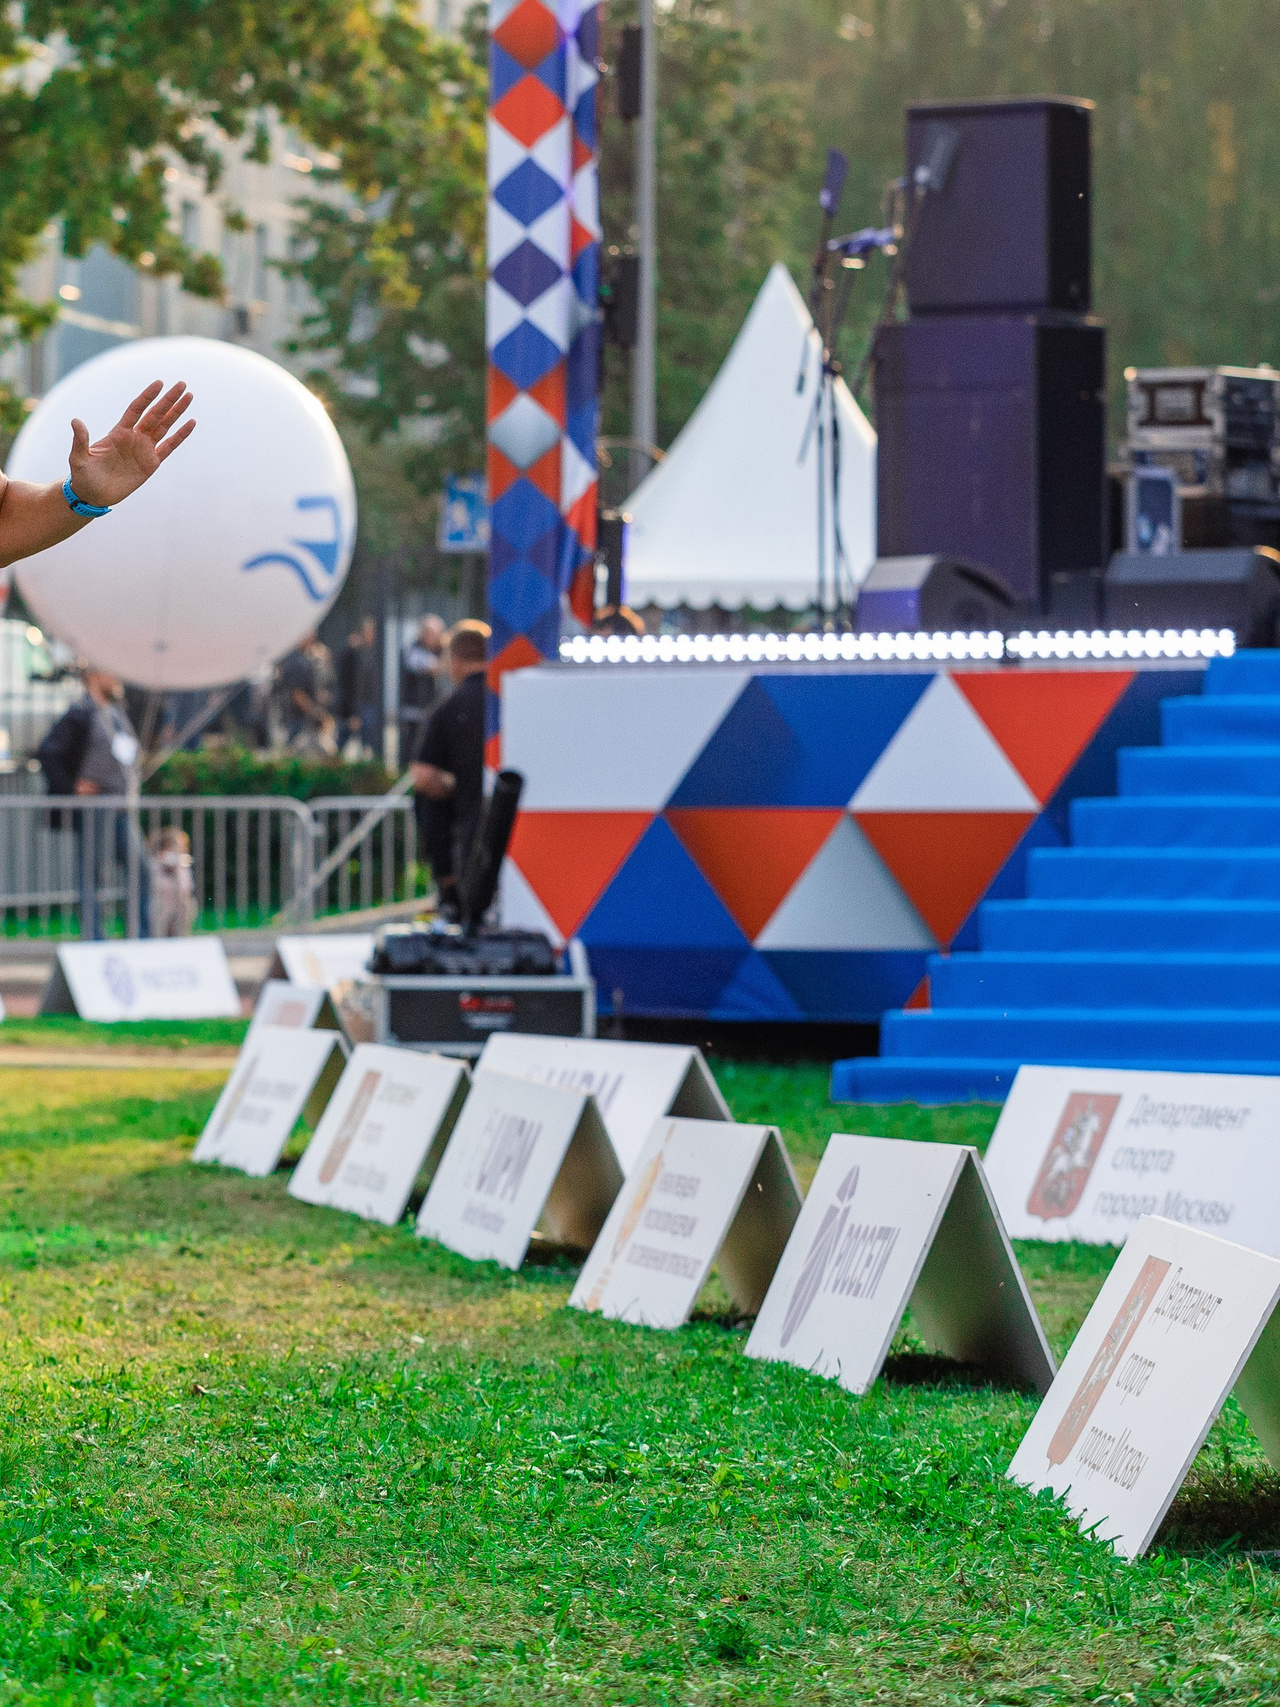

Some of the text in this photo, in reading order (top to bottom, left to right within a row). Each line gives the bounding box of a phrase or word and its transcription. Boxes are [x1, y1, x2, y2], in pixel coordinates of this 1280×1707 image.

[1124, 1093, 1252, 1133] Департамент
[1110, 1146, 1175, 1178] спорта
[1092, 1190, 1235, 1225] города Москвы
[822, 1222, 901, 1300] РОССЕТИ
[1148, 1266, 1223, 1333] Департамент
[1115, 1352, 1156, 1405] спорта
[1075, 1425, 1150, 1492] города Москвы
